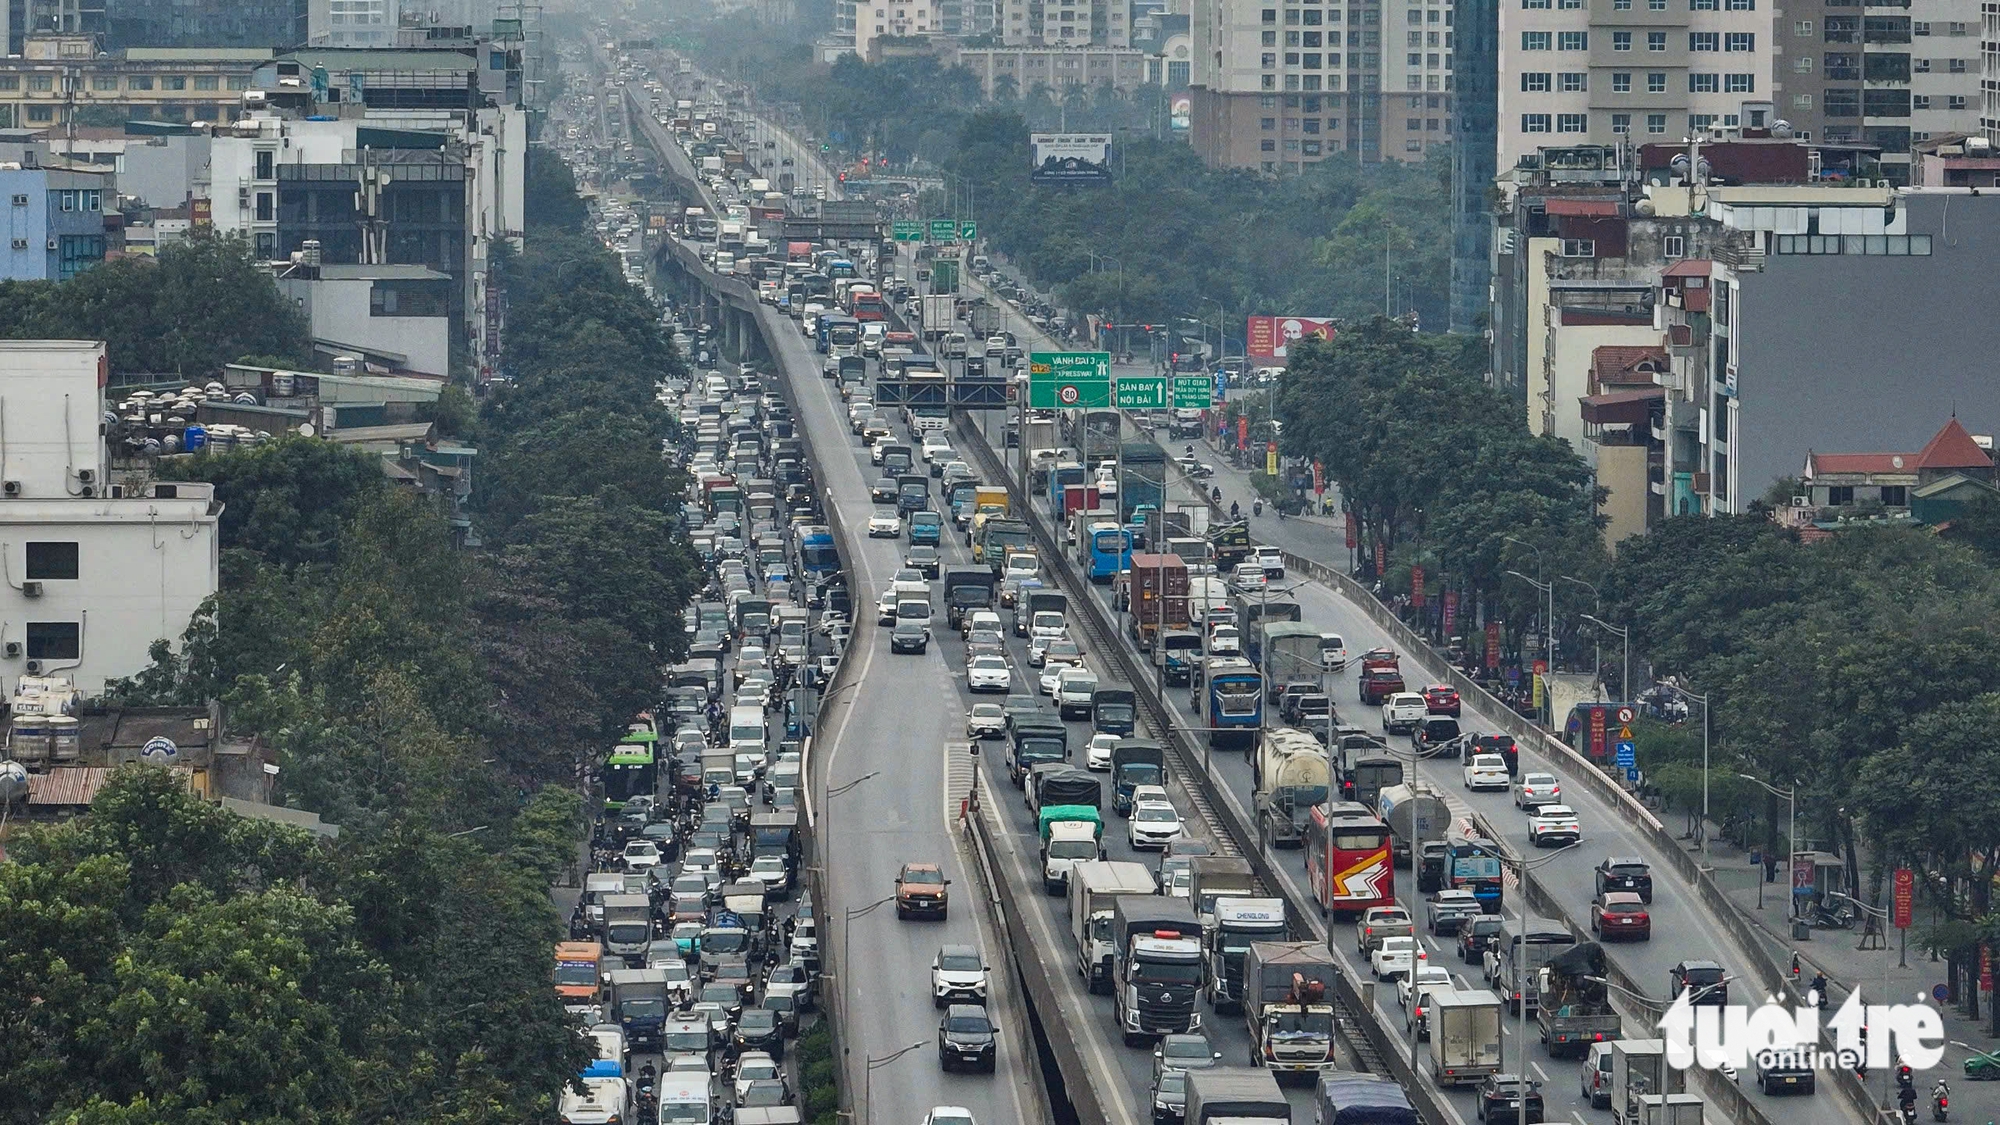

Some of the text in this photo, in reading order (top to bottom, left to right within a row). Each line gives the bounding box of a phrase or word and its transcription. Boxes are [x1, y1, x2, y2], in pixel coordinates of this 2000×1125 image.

[1090, 356, 1095, 364] 3
[1119, 382, 1154, 391] SÂN BAY
[1192, 379, 1207, 387] GIAO
[1065, 390, 1075, 399] 80
[1120, 394, 1151, 405] NỘI BÀI
